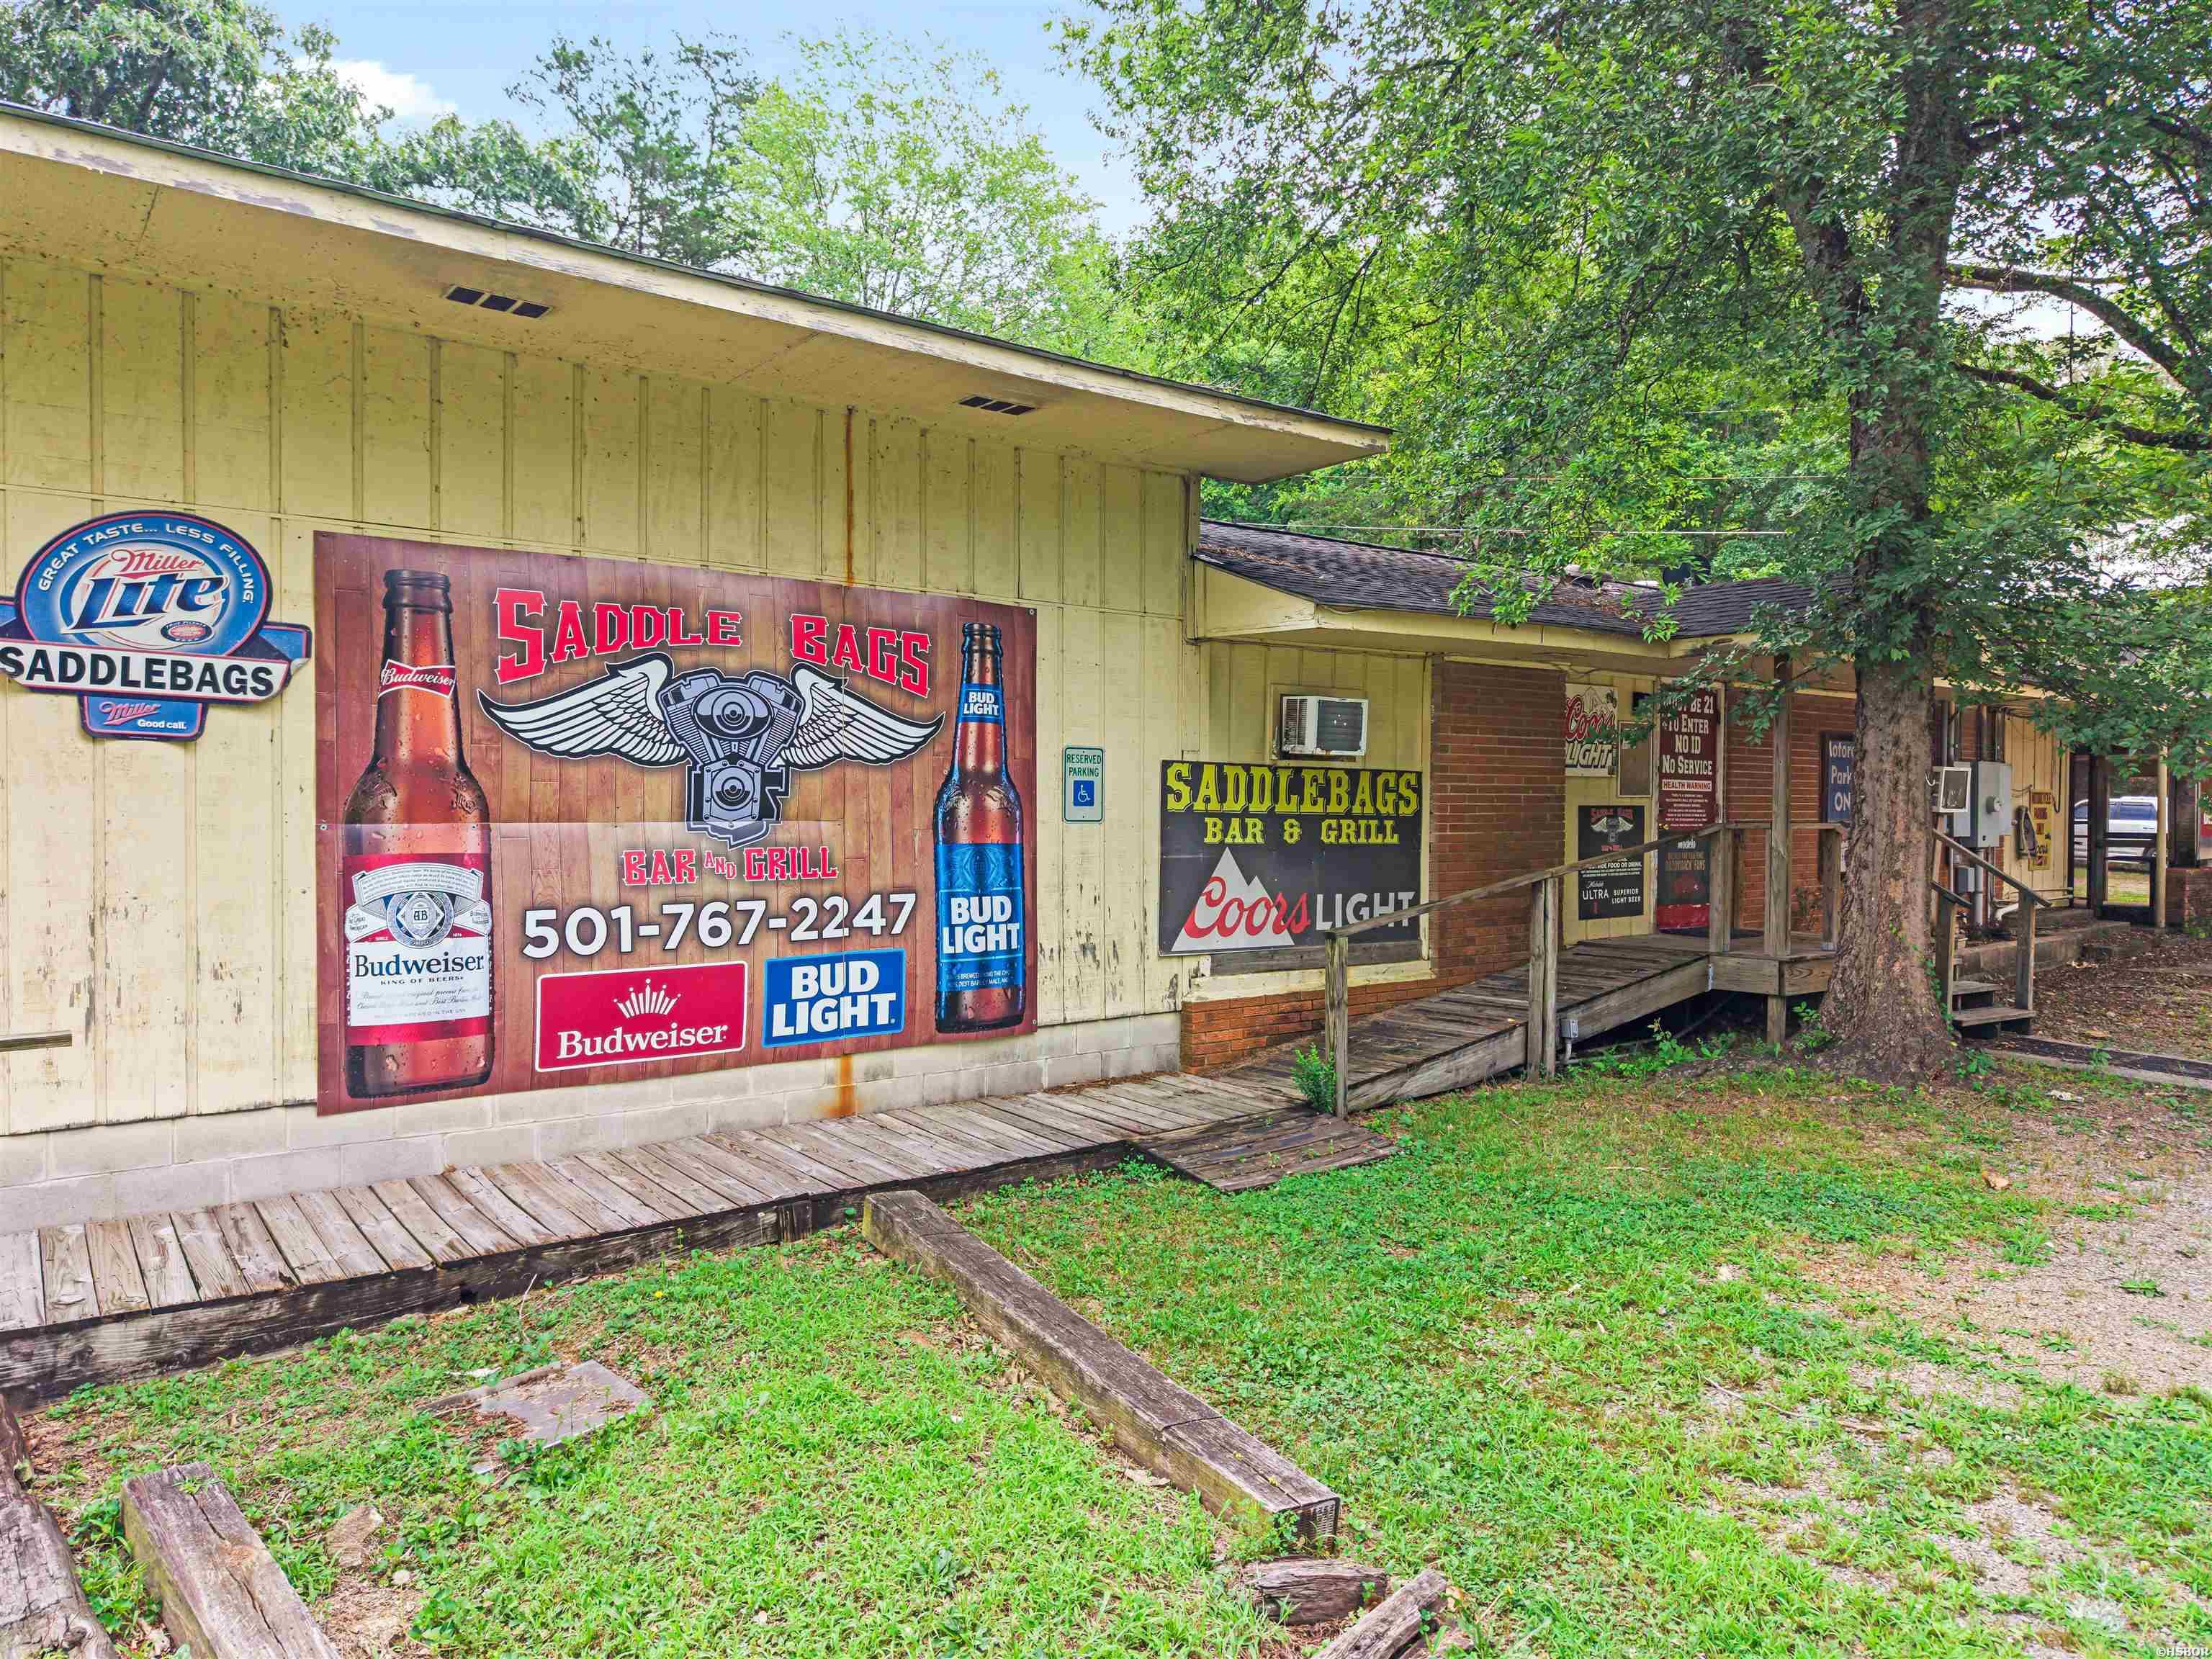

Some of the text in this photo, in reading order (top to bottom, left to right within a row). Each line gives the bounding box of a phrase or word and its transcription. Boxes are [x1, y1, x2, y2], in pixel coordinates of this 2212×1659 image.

[38, 543, 78, 592] GREAT
[82, 523, 158, 546] TASTE...
[165, 523, 215, 545] LESS
[112, 549, 205, 576] Miller
[60, 572, 230, 634] Lite
[493, 587, 932, 698] SADDLE BAGS
[0, 645, 274, 697] SADDLEBAGS
[380, 667, 455, 686] Budweiser
[963, 703, 999, 717] LIGHT
[968, 691, 995, 705] BUD
[1704, 695, 1714, 714] 21
[99, 701, 161, 724] Miller
[138, 719, 187, 730] Good call.
[1681, 714, 1709, 734] ENTER
[1566, 741, 1613, 768] LIGHT
[1675, 734, 1701, 755] NO ID
[1066, 753, 1102, 765] RESERVED
[1069, 767, 1100, 778] PARKING
[1677, 755, 1713, 775] SERVICE
[1166, 761, 1420, 817] SADDLEBAGS
[1663, 781, 1712, 791] HEALTH WARNING
[1203, 817, 1400, 845] BAR & GRILL
[621, 845, 839, 886] BAR AND GRILL
[1184, 876, 1417, 939] Coors LIGHT
[1583, 889, 1609, 900] ULTRA
[950, 895, 1012, 925] BUD
[521, 892, 917, 959] 501-767-2247
[942, 922, 1021, 955] LIGHT
[354, 951, 484, 978] Budweiser
[791, 960, 880, 1001] BUD
[771, 993, 897, 1038] LIGHT
[557, 1022, 728, 1060] Budweiser
